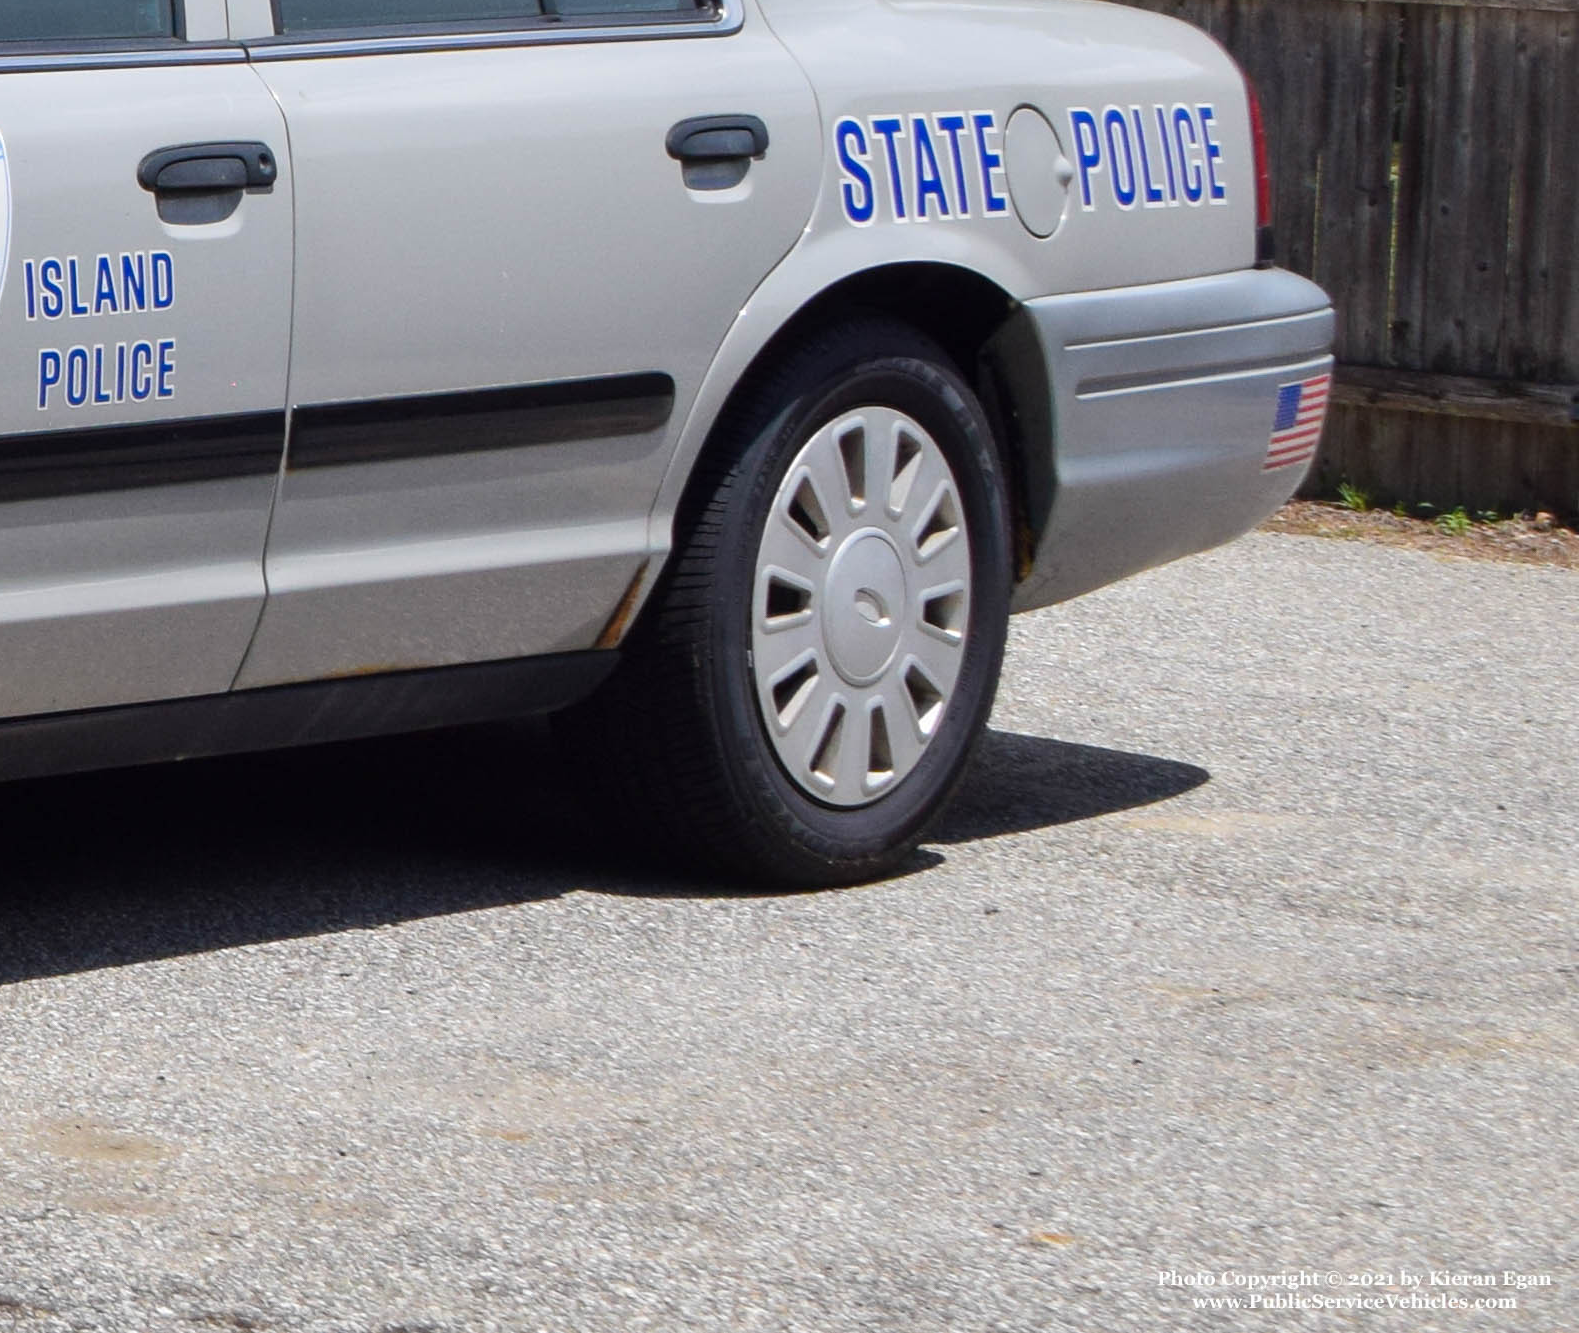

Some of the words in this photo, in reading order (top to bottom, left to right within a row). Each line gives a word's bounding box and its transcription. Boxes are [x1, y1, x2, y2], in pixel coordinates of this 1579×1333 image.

[833, 109, 1010, 228] STATE
[1067, 102, 1228, 213] POLICE
[23, 250, 175, 321] ISLAND
[37, 338, 176, 410] POLICE
